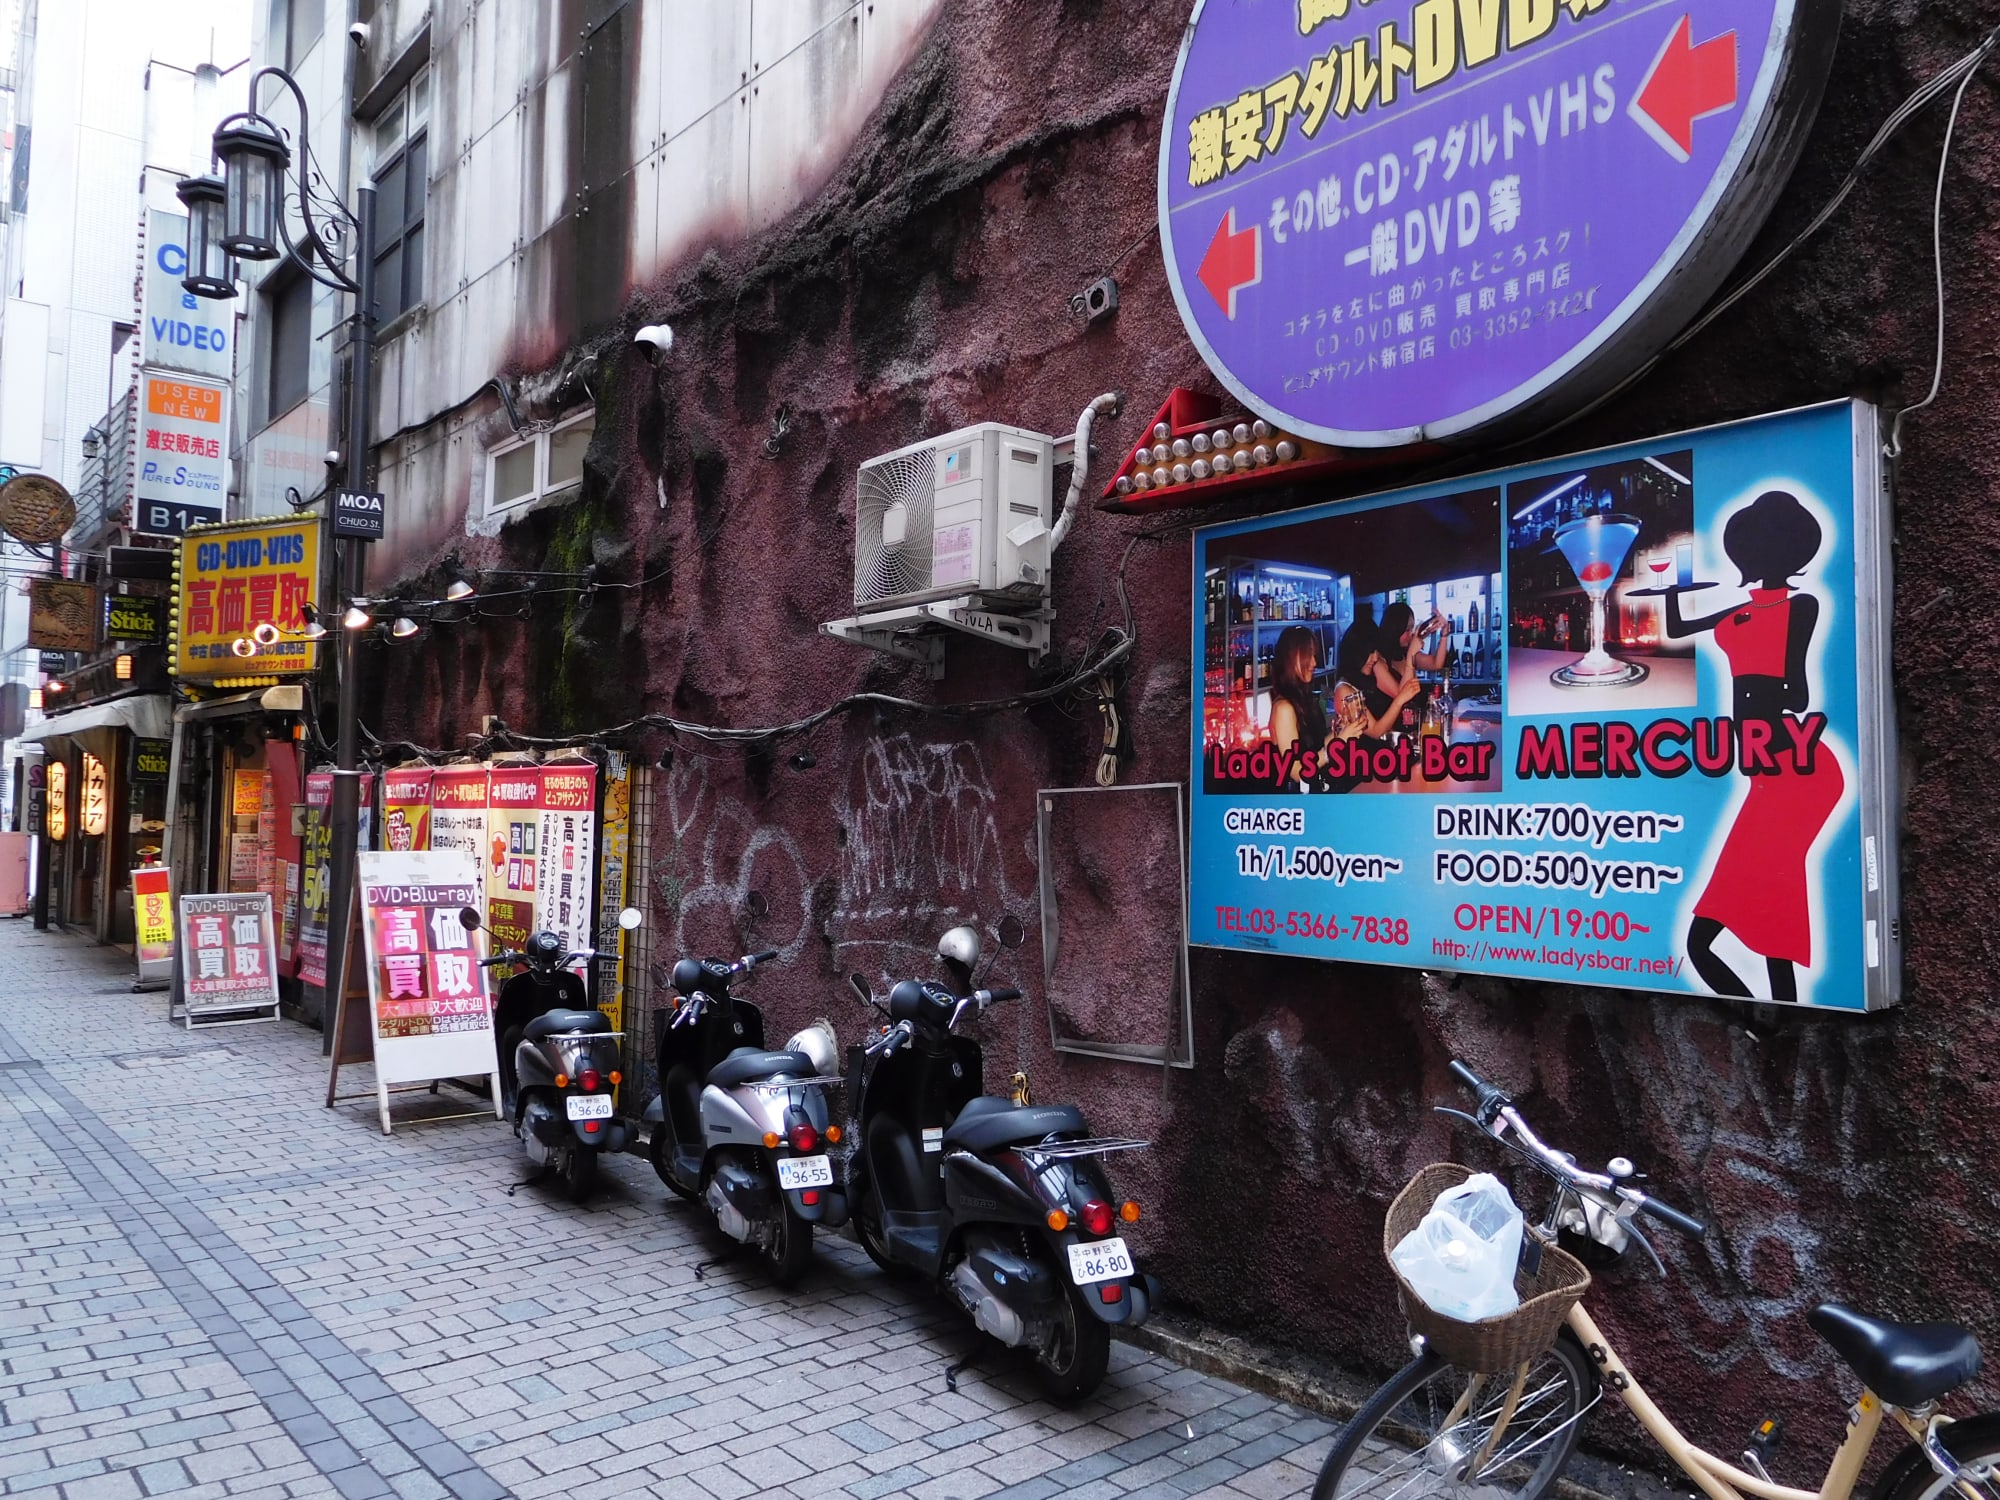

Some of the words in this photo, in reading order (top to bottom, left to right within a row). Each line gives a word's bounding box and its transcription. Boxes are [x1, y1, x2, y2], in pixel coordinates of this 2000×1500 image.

[1455, 261, 1572, 319] 買取専門店
[182, 293, 198, 310] &
[151, 316, 226, 352] VIDEO
[155, 383, 215, 404] USED
[163, 400, 208, 420] NEW
[146, 428, 220, 459] 激安販売店
[173, 466, 220, 491] SOUND
[339, 493, 382, 511] MOA
[338, 516, 368, 527] CHUO
[370, 520, 381, 529] St.
[187, 572, 309, 636] 高価買取
[1212, 745, 1319, 784] Lady's
[1328, 741, 1411, 780] Shot
[1424, 738, 1493, 778] Bar
[1518, 713, 1824, 778] MERCURY
[52, 772, 64, 832] アカシア
[89, 758, 104, 828] アカシア
[544, 791, 589, 807] ピュアサウンド
[1226, 812, 1302, 832] CHARGE
[1215, 905, 1410, 946] TEL:03-5366-7838
[1432, 937, 1685, 979] http://www.ladysbar.net/
[578, 1104, 609, 1116] 96-60
[1032, 1110, 1068, 1120] HONDA
[792, 1168, 828, 1183] 96-55
[1085, 1255, 1128, 1277] 86-80
